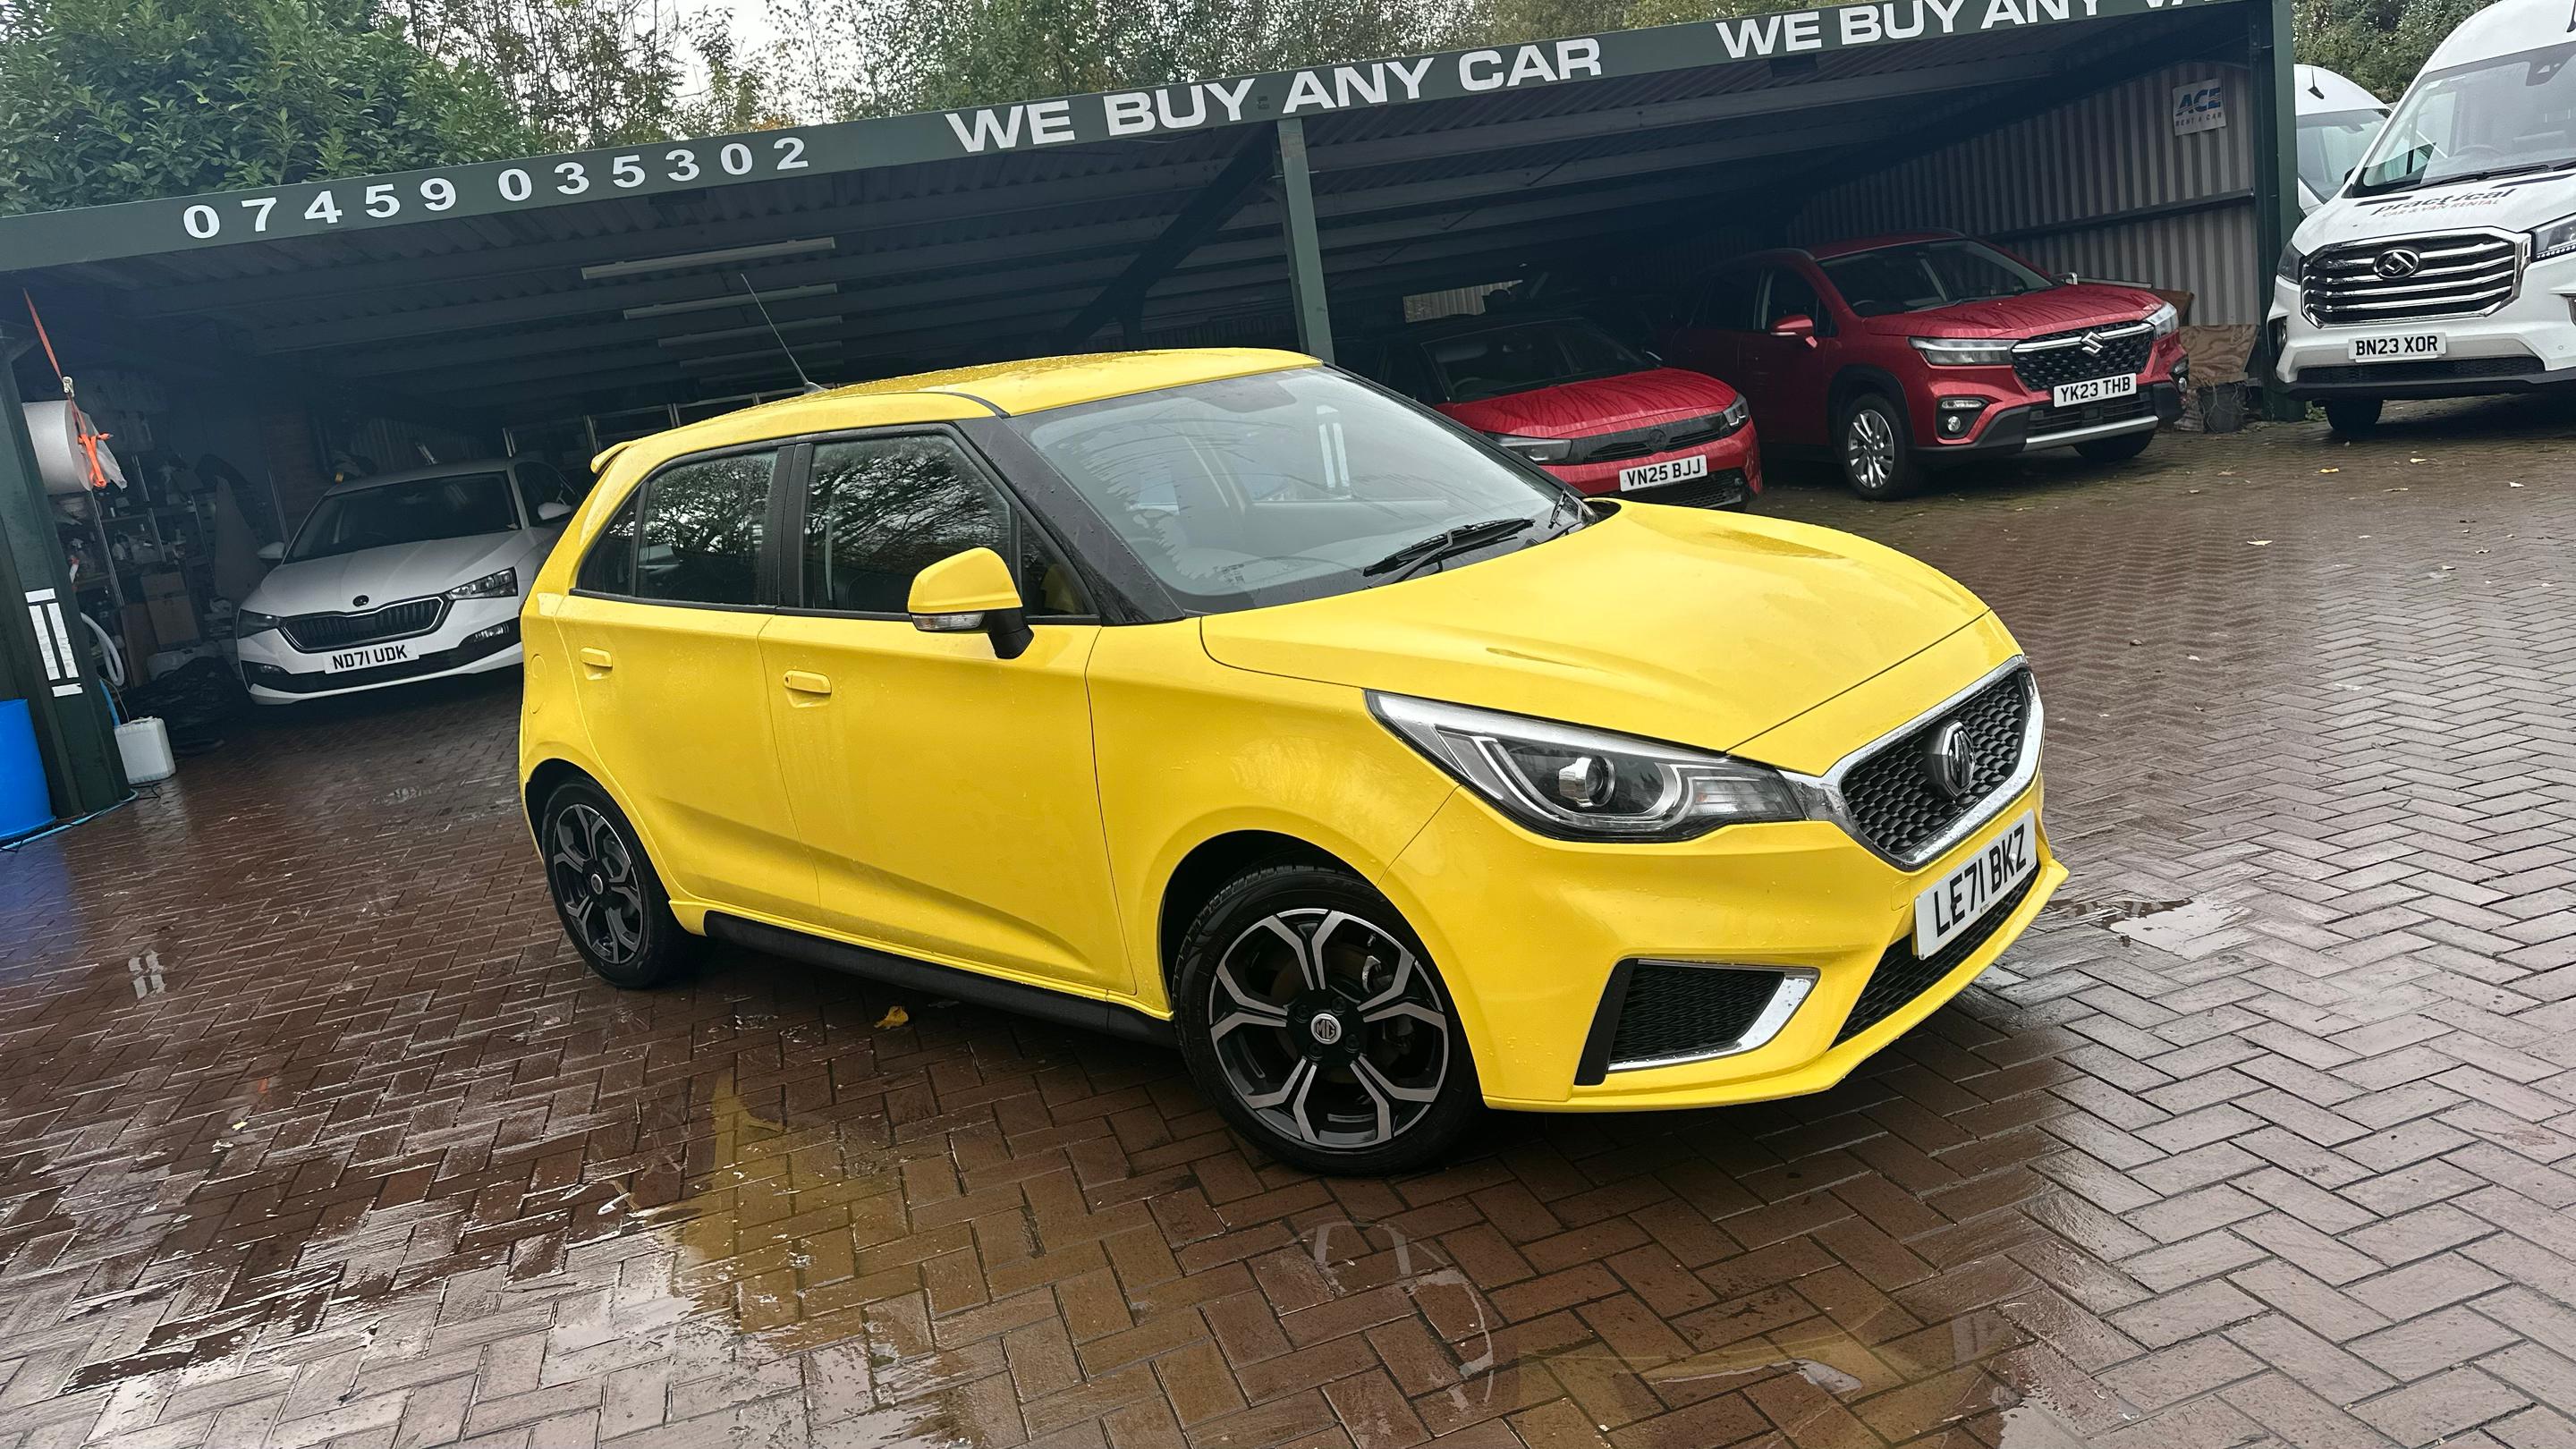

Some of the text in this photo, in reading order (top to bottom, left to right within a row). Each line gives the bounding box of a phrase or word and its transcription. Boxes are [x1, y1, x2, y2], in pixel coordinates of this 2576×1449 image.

[1716, 12, 1822, 58] WE
[1839, 0, 1964, 46] BUY
[945, 38, 1602, 153] WE BUY ANY CAR
[2175, 87, 2221, 116] ACE
[182, 137, 809, 240] 07459 035302
[2370, 188, 2517, 216] practical
[2421, 204, 2449, 212] VAN
[2450, 199, 2498, 208] RENTAL
[2355, 335, 2438, 356] BN23 XOR
[2061, 377, 2131, 402] YK23 THB
[1627, 458, 1701, 487] VN25 BJJ
[332, 644, 407, 670] ND71 UDK
[1934, 823, 2027, 938] LE71 BKZ
[1316, 1020, 1335, 1038] MG
